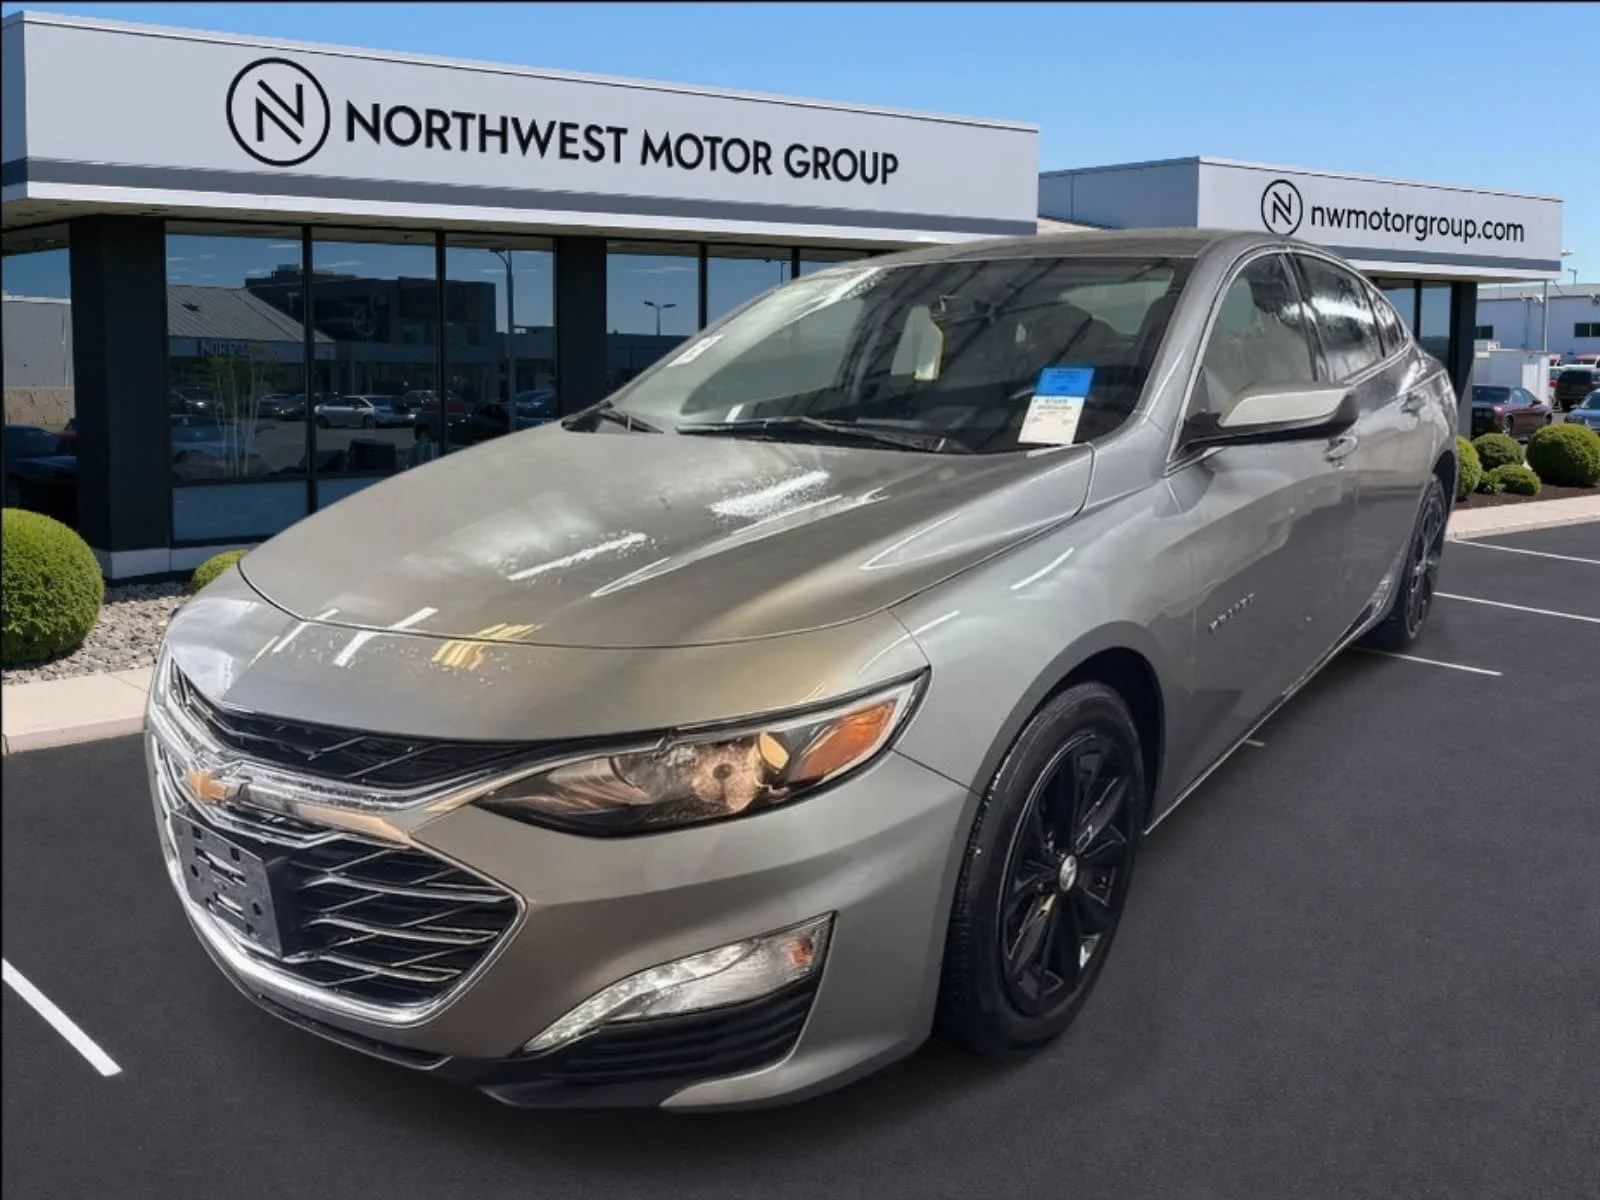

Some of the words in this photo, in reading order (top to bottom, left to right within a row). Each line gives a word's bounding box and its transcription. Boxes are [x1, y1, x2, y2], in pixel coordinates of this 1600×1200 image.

[347, 100, 628, 164] NORTHWEST
[641, 130, 773, 176] MOTOR
[784, 144, 899, 185] GROUP
[1311, 206, 1524, 244] nwmotorgroup.com
